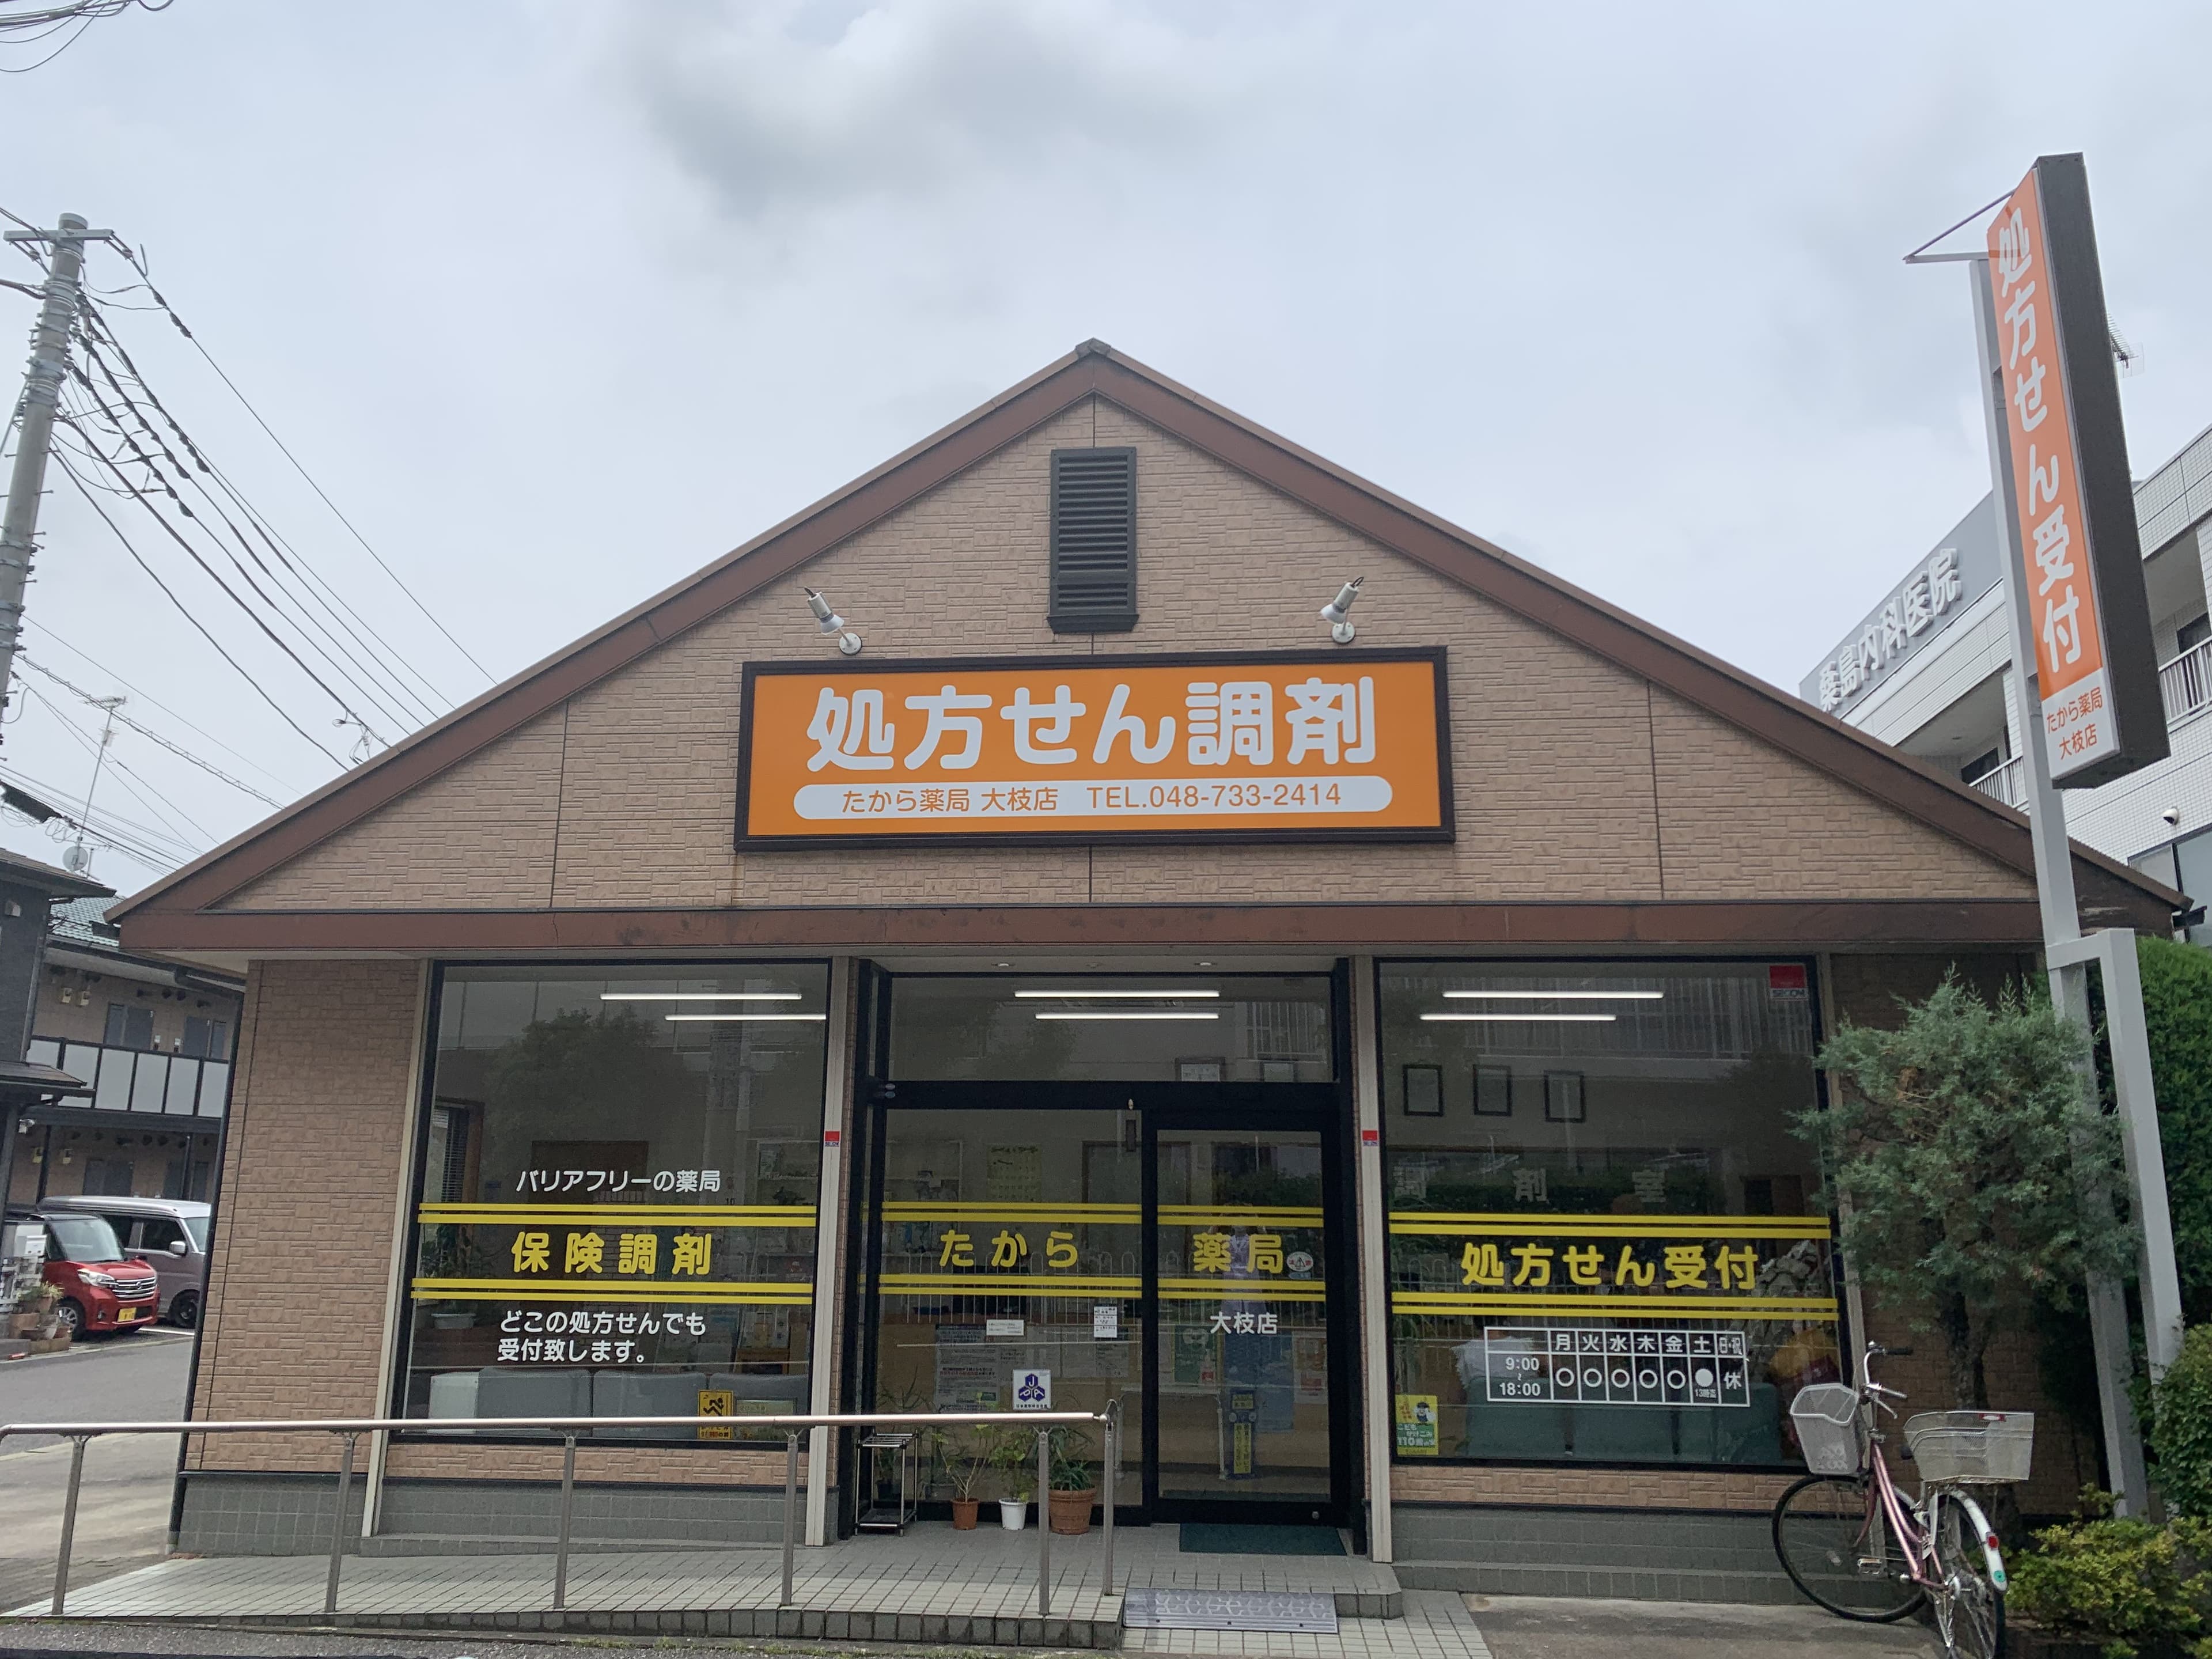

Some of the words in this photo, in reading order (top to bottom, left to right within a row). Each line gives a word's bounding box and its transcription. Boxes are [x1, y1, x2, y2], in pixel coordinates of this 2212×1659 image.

[1999, 207, 2081, 673] 処方せん受付
[2046, 686, 2103, 734] たから薬局
[806, 676, 1376, 773] 処方せん調剤
[2058, 723, 2098, 760] 大枝店
[843, 789, 970, 813] たから薬局
[982, 787, 1058, 812] 大枝店
[516, 1169, 721, 1192] バリアフリーの薬局
[511, 1231, 712, 1275] 保険調剤
[939, 1229, 1078, 1268] たから
[1193, 1232, 1283, 1274] 薬局
[1461, 1243, 1758, 1290] 処方せん受付
[500, 1310, 706, 1335] どこの処方せんでも
[1210, 1311, 1278, 1334] 大枝店
[497, 1338, 645, 1363] 受付致します。
[1555, 1334, 1571, 1351] 月
[1582, 1335, 1600, 1352] 火
[1609, 1335, 1628, 1352] 水
[1637, 1335, 1656, 1353] 木
[1665, 1335, 1684, 1353] 金
[1694, 1336, 1711, 1353] 土
[1505, 1357, 1540, 1371] 9:00
[1499, 1382, 1541, 1396] 18:00
[1724, 1372, 1743, 1390] 休
